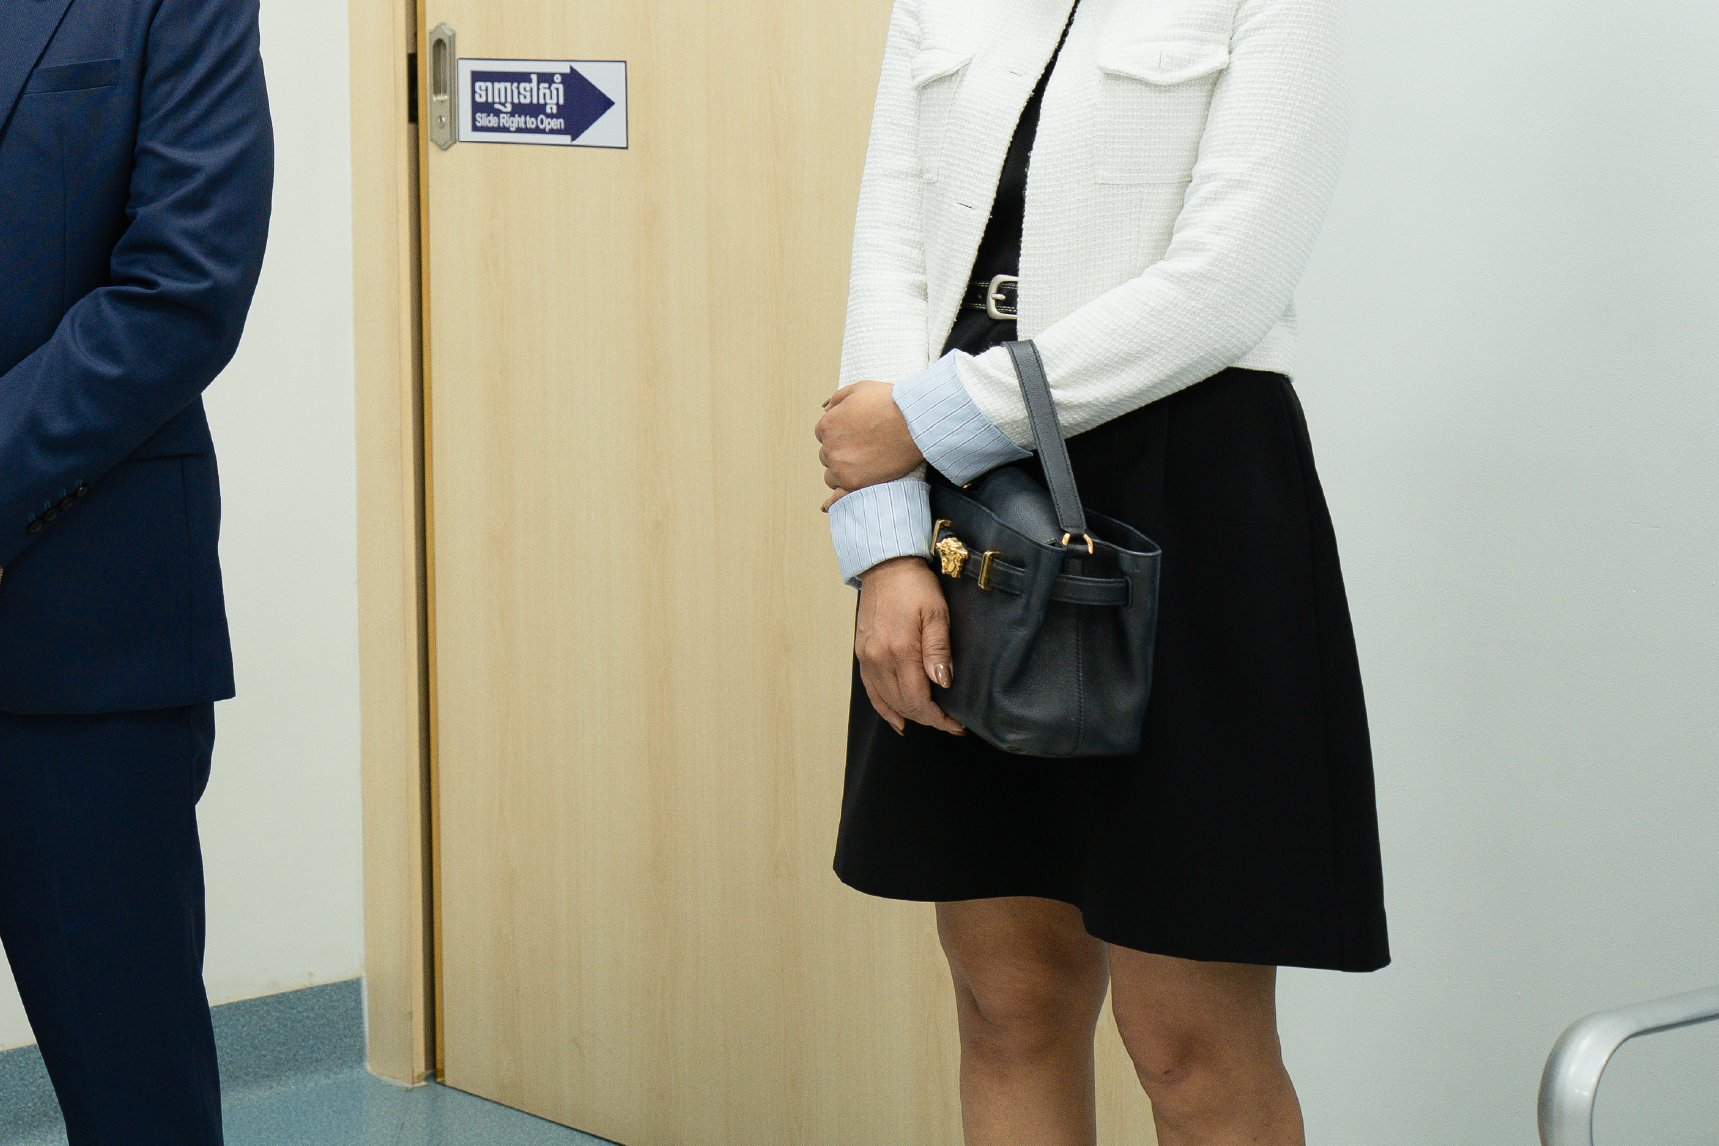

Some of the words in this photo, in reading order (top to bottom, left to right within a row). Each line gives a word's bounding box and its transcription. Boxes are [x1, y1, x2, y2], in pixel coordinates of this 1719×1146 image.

[475, 113, 499, 128] Slide
[499, 113, 526, 131] Right
[526, 115, 537, 129] to
[537, 114, 565, 132] Open
